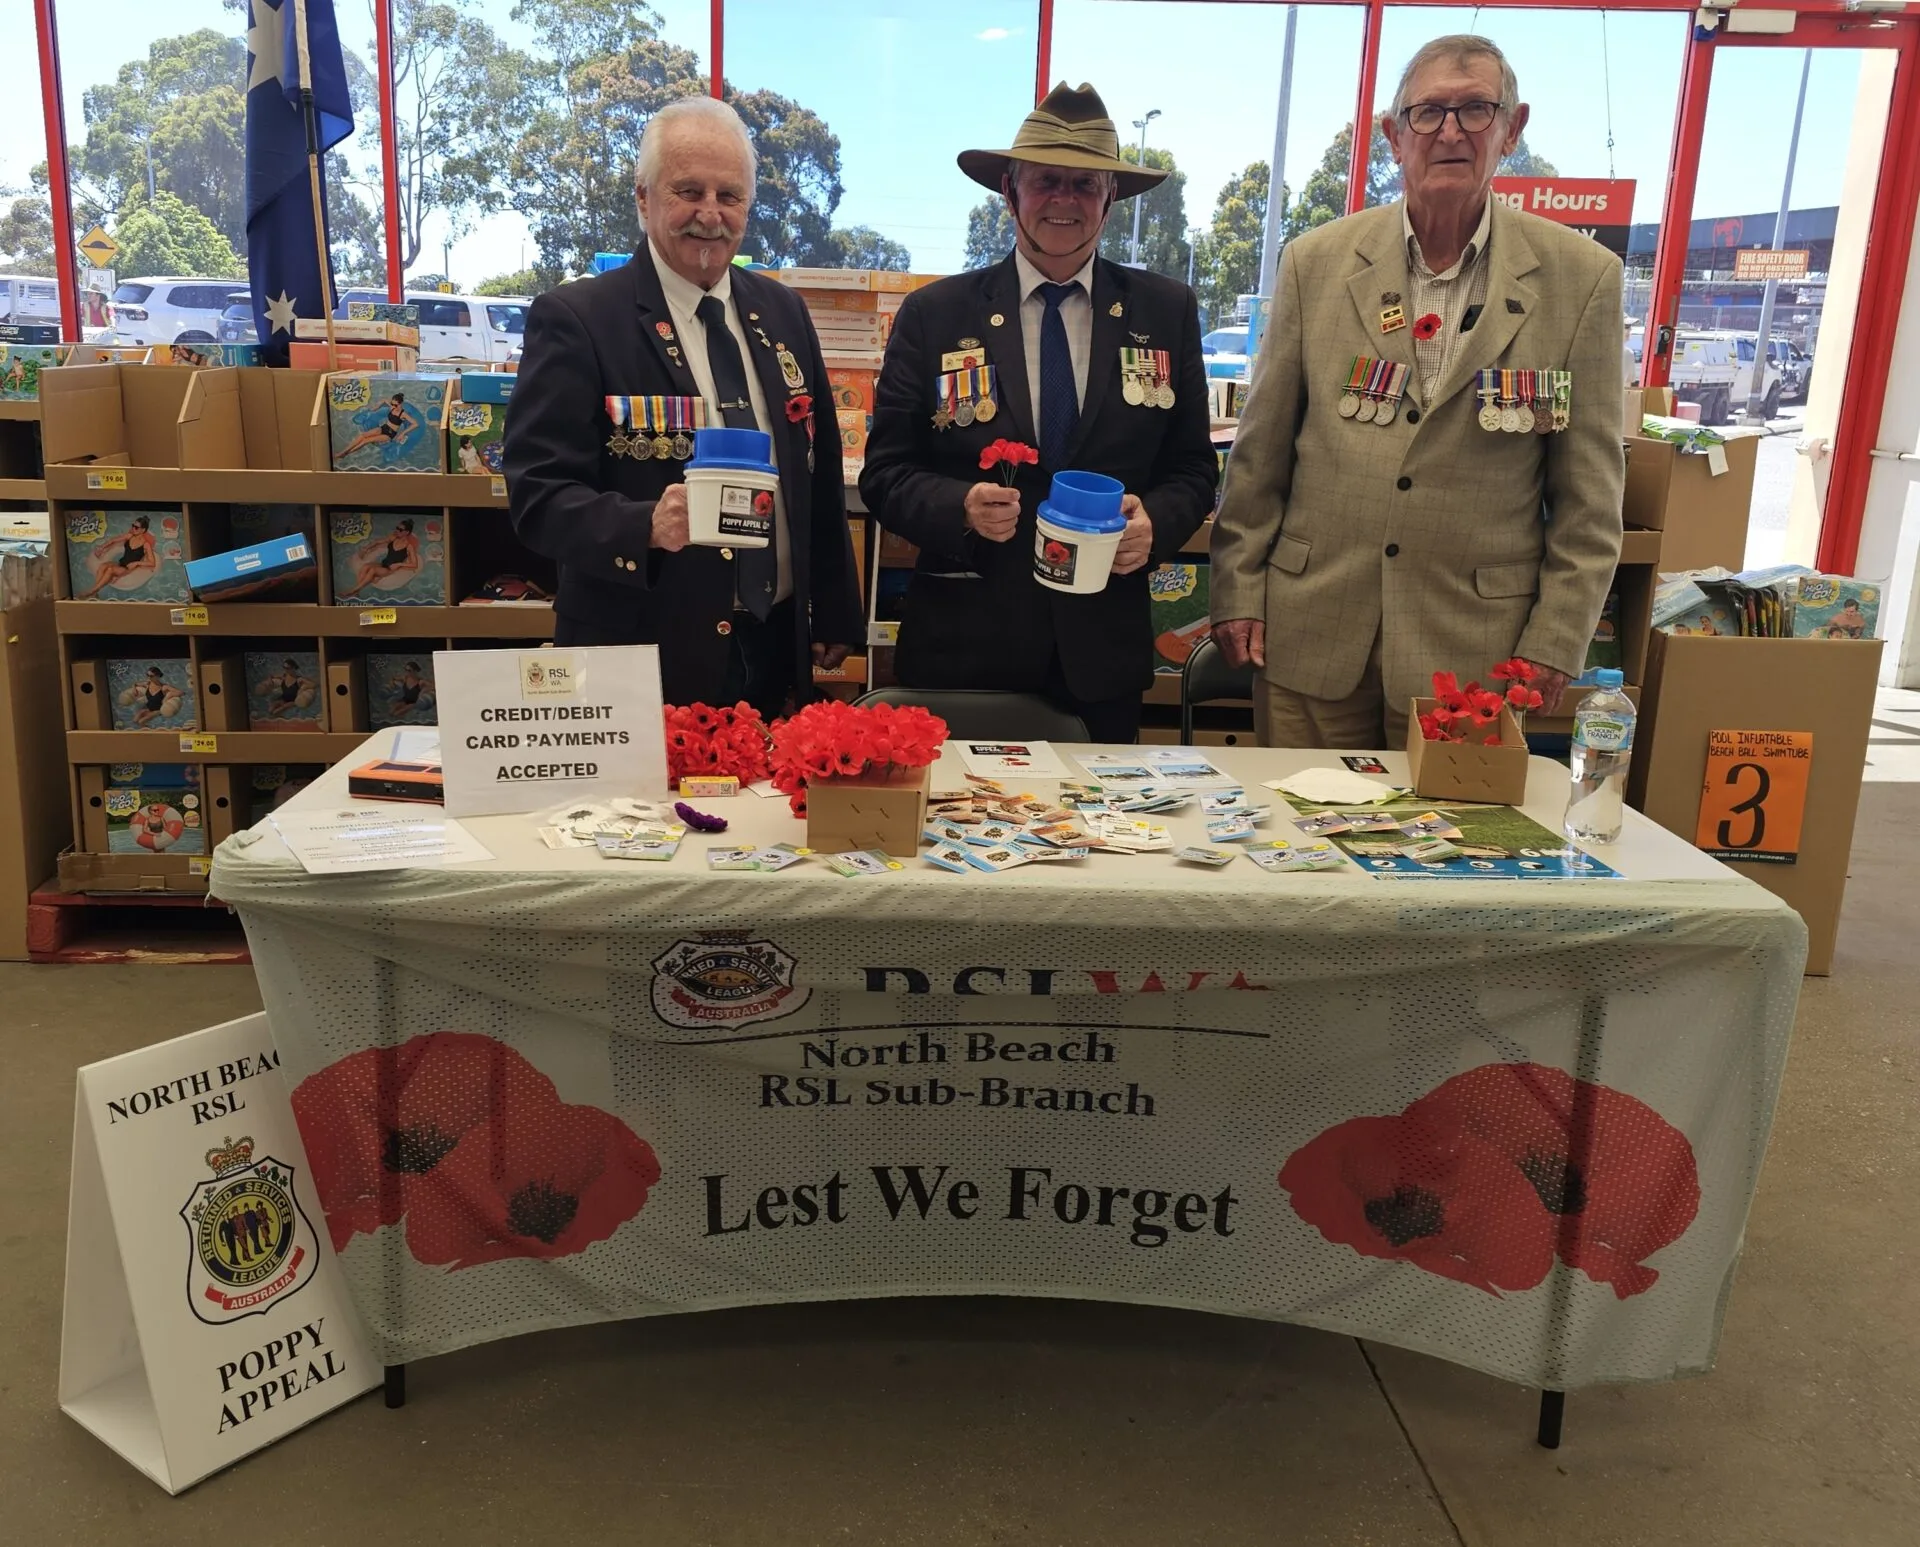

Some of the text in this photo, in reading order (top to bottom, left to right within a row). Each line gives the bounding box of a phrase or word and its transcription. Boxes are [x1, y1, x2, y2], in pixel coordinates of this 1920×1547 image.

[1532, 187, 1608, 211] Hours
[1740, 252, 1805, 265] FIRE SAFETY DOOR
[1765, 264, 1804, 272] OBSTRUCT
[344, 387, 363, 401] GO!
[464, 413, 485, 426] GO!
[80, 521, 100, 534] GO!
[345, 522, 364, 535] GO!
[722, 517, 761, 529] POPPY APPEAL
[1163, 576, 1188, 591] GO!
[1812, 589, 1833, 600] GO!
[549, 668, 571, 678] RSL
[481, 705, 613, 722] CREDIT/DEBIT
[466, 731, 630, 750] CARD PAYMENTS
[1587, 730, 1620, 740] FRANKLIN
[1711, 731, 1793, 746] POOL INFLATABLE
[1710, 745, 1734, 757] BEACH
[1738, 746, 1757, 757] BALL
[496, 762, 599, 780] ACCEPTED
[118, 797, 134, 809] GO!
[1717, 763, 1770, 848] 3
[695, 1003, 772, 1018] AUSTRALIA
[799, 1032, 1116, 1070] North Beach
[106, 1070, 212, 1126] NORTH
[758, 1074, 1156, 1117] RSL Sub-Branch
[190, 1090, 247, 1127] RSL
[701, 1165, 1239, 1248] Lest We Forget
[201, 1190, 233, 1261] RETURNED
[244, 1181, 292, 1225] SERVICES
[232, 1254, 281, 1283] LEAGUE
[230, 1274, 293, 1310] AUSTRALIA
[216, 1317, 328, 1394] POPPY
[216, 1349, 347, 1435] APPEAL
